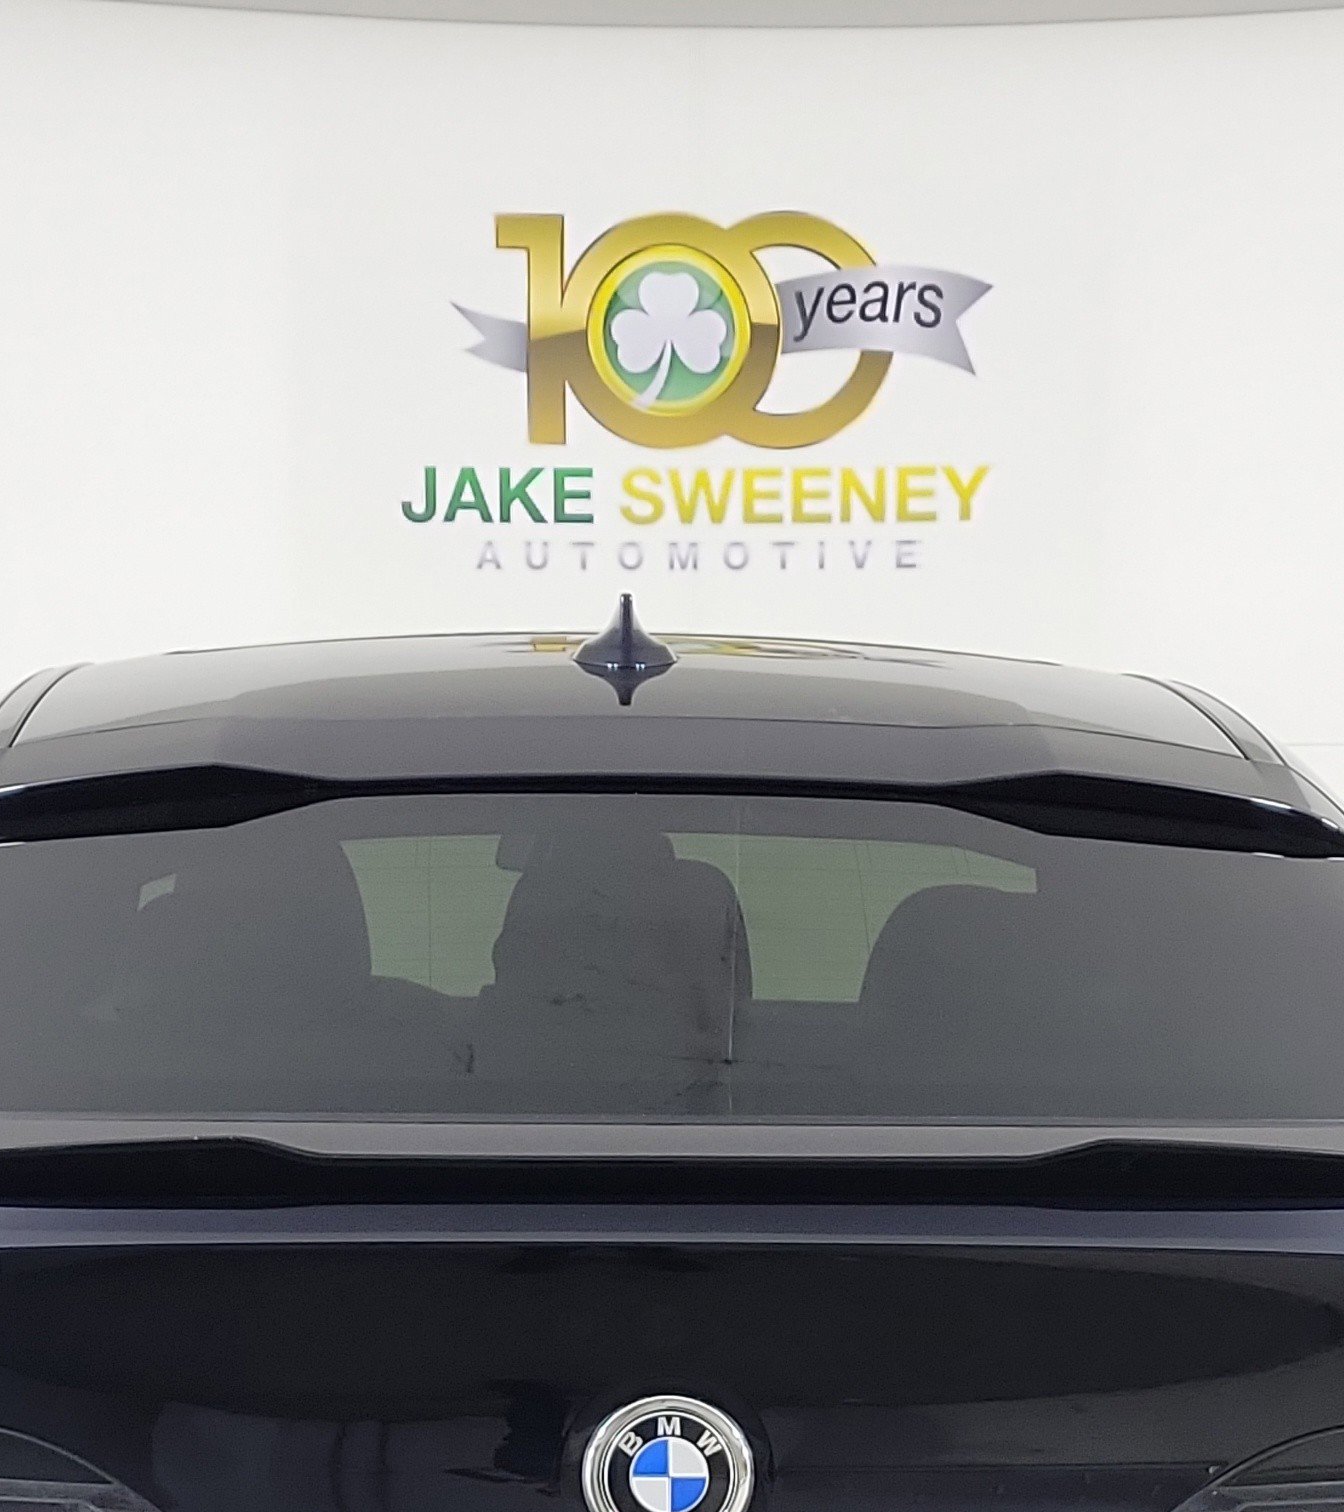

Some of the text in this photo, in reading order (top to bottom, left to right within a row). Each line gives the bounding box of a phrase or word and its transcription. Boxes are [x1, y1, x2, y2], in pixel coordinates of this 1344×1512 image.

[494, 210, 944, 449] 100 years
[401, 464, 991, 526] JAKE SWEENEY
[476, 539, 923, 572] AUTOMOTIVE
[617, 1416, 722, 1457] BMW
